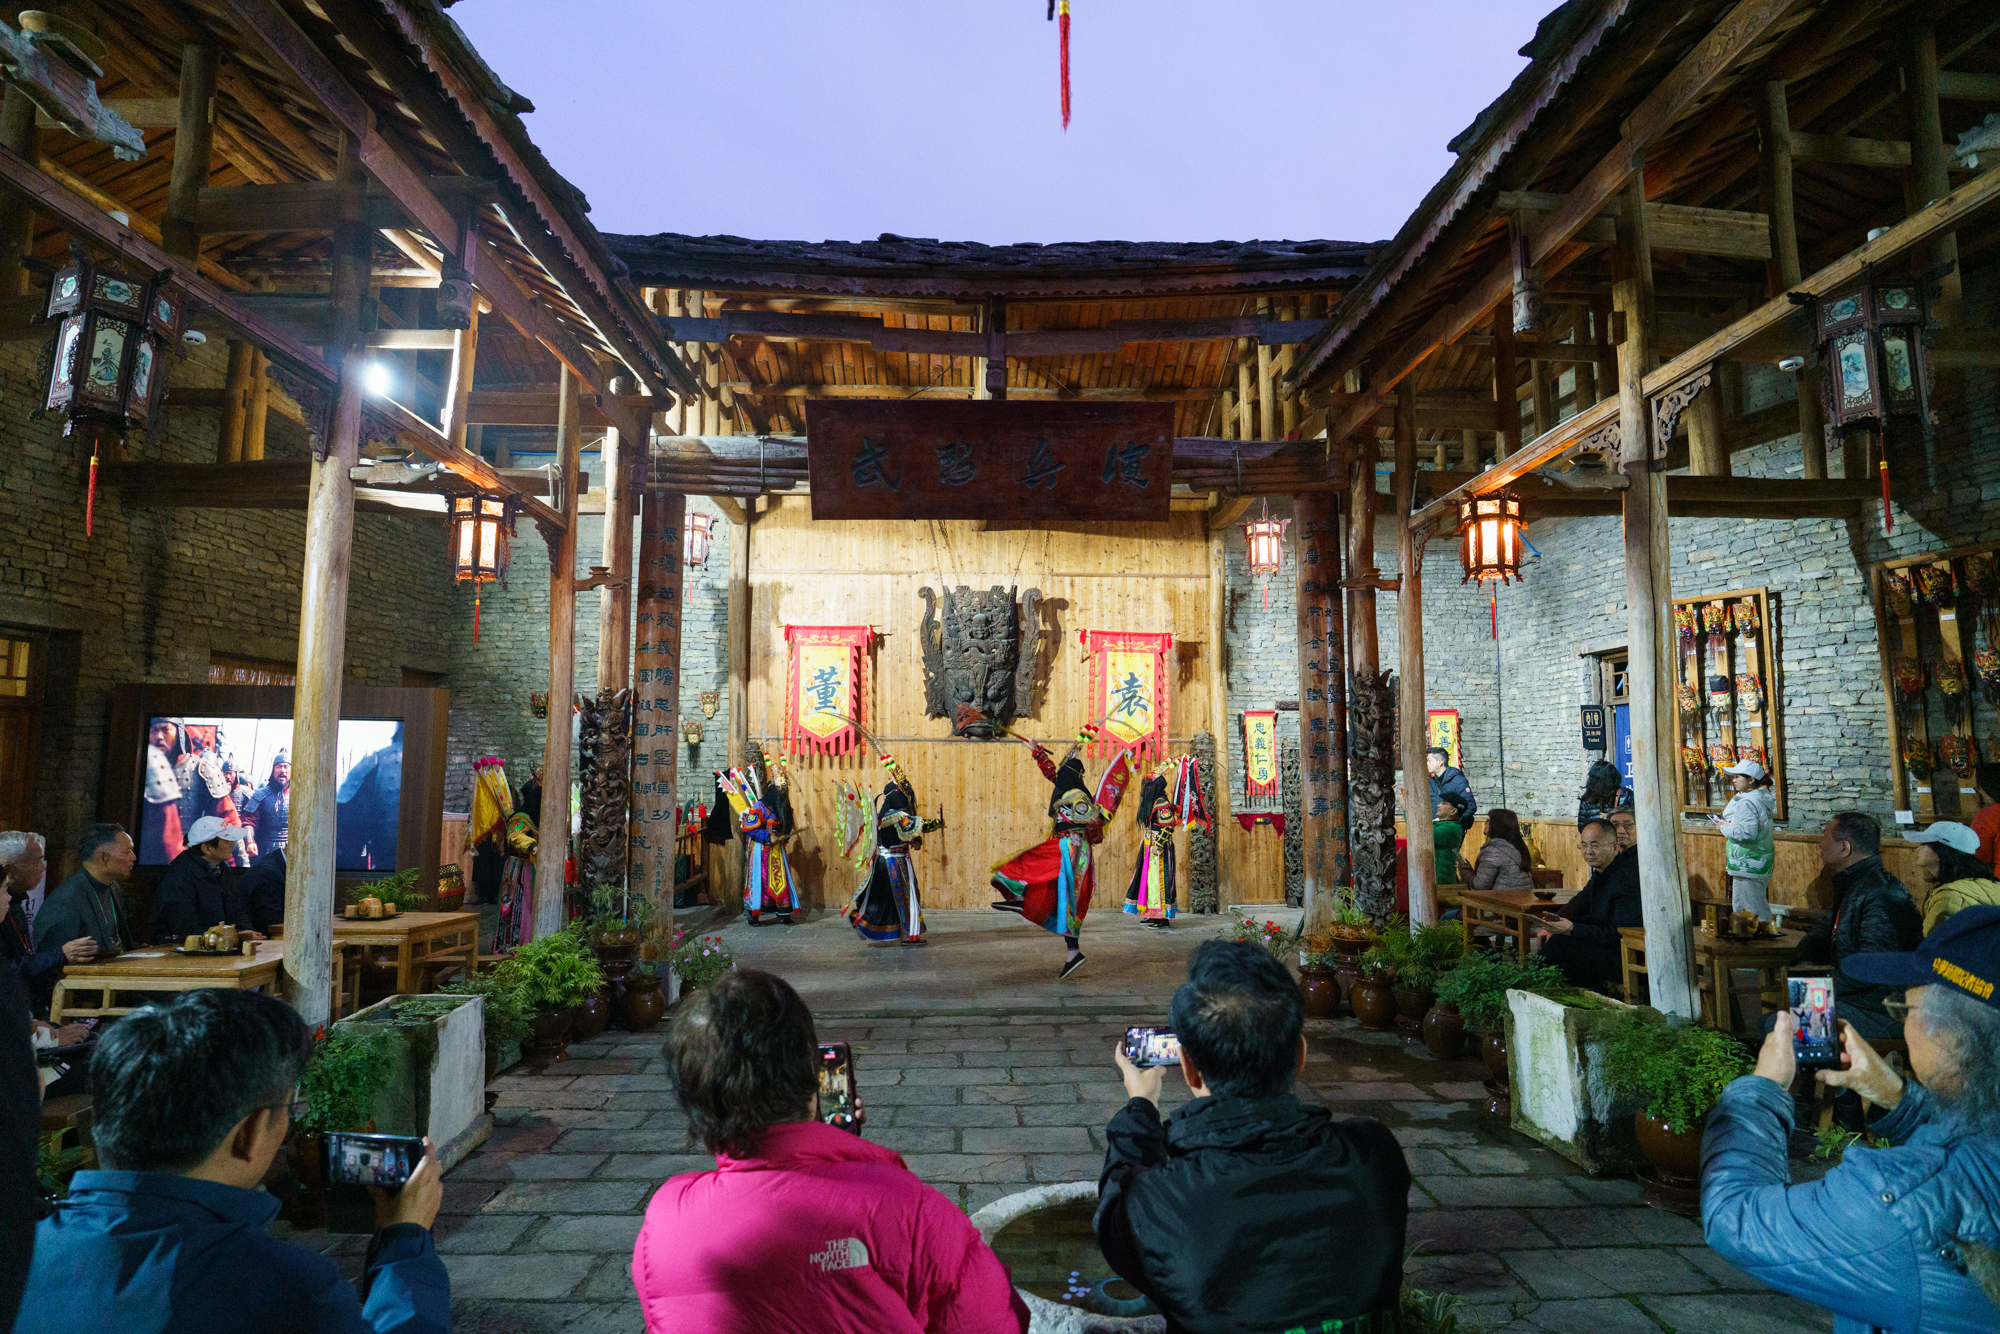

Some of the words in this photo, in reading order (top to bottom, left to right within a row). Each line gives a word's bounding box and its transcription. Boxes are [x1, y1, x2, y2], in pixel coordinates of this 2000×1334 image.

[806, 666, 842, 713] 董
[1111, 671, 1149, 718] 袁
[1437, 720, 1452, 749] 慈善
[1253, 721, 1269, 781] 忠義仁勇
[809, 1247, 849, 1264] NORTH
[825, 1238, 849, 1253] THE
[820, 1258, 850, 1272] FACE
